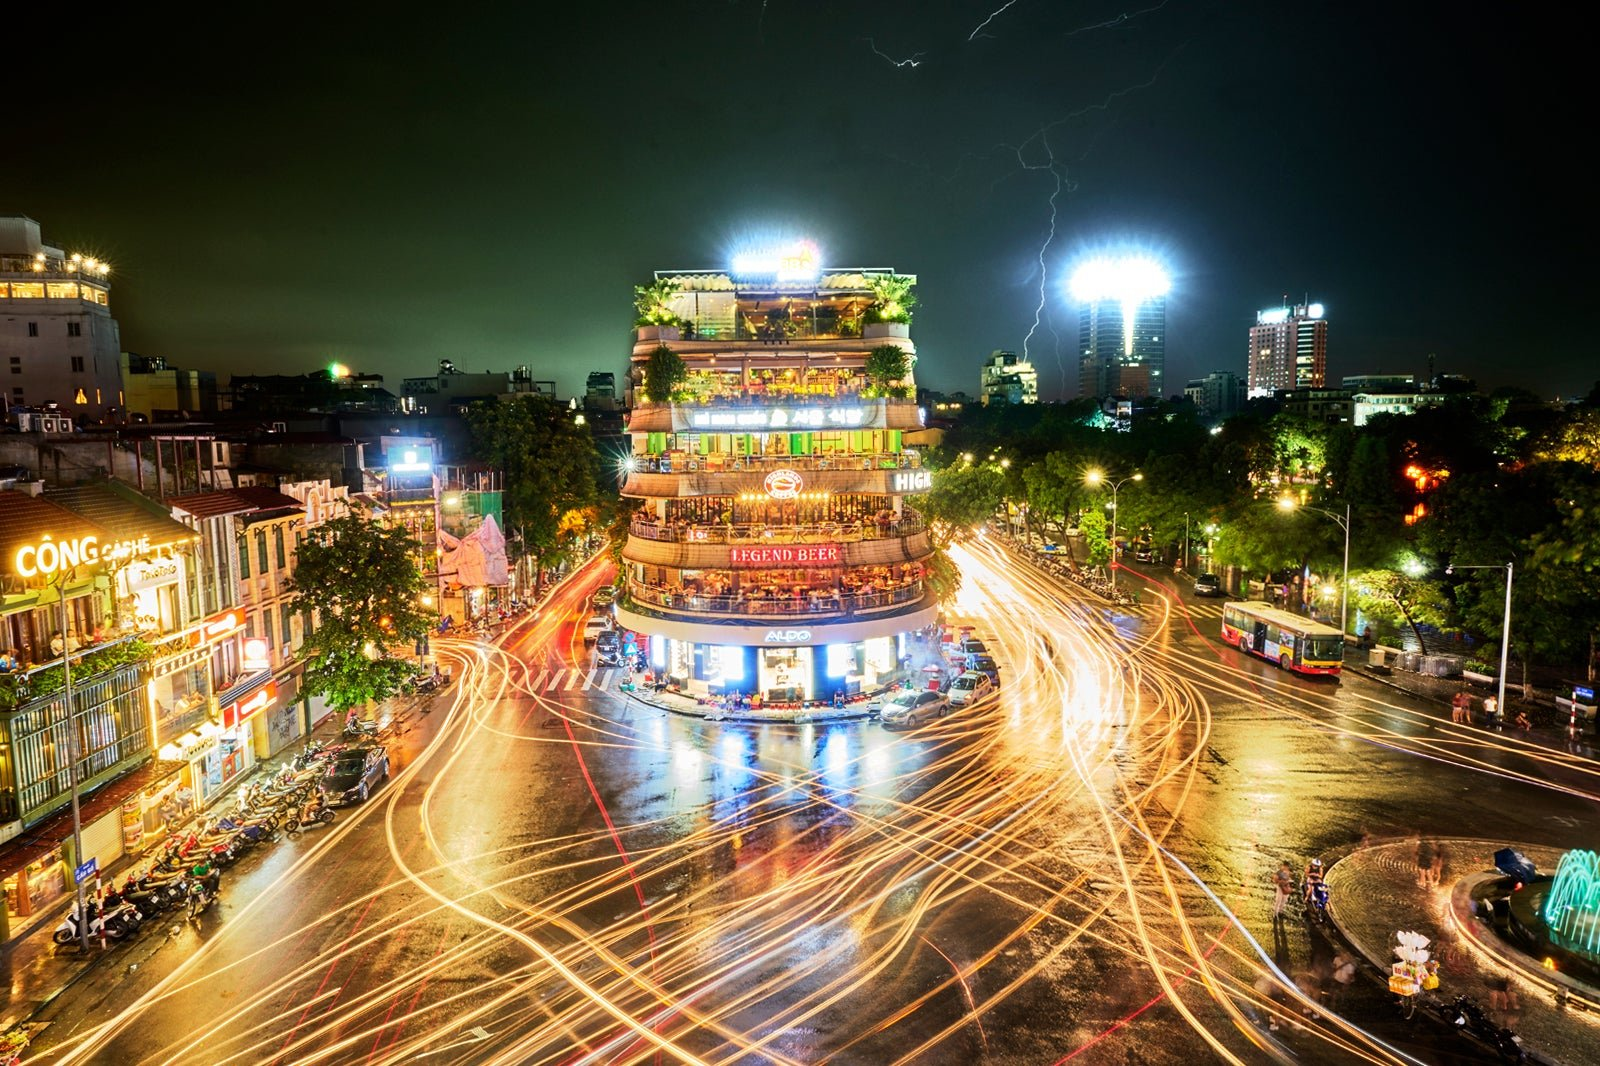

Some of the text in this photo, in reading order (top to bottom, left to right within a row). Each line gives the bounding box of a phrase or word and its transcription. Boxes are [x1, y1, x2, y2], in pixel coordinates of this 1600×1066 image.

[733, 547, 837, 561] LEGEND BEER
[765, 630, 812, 642] ALDO
